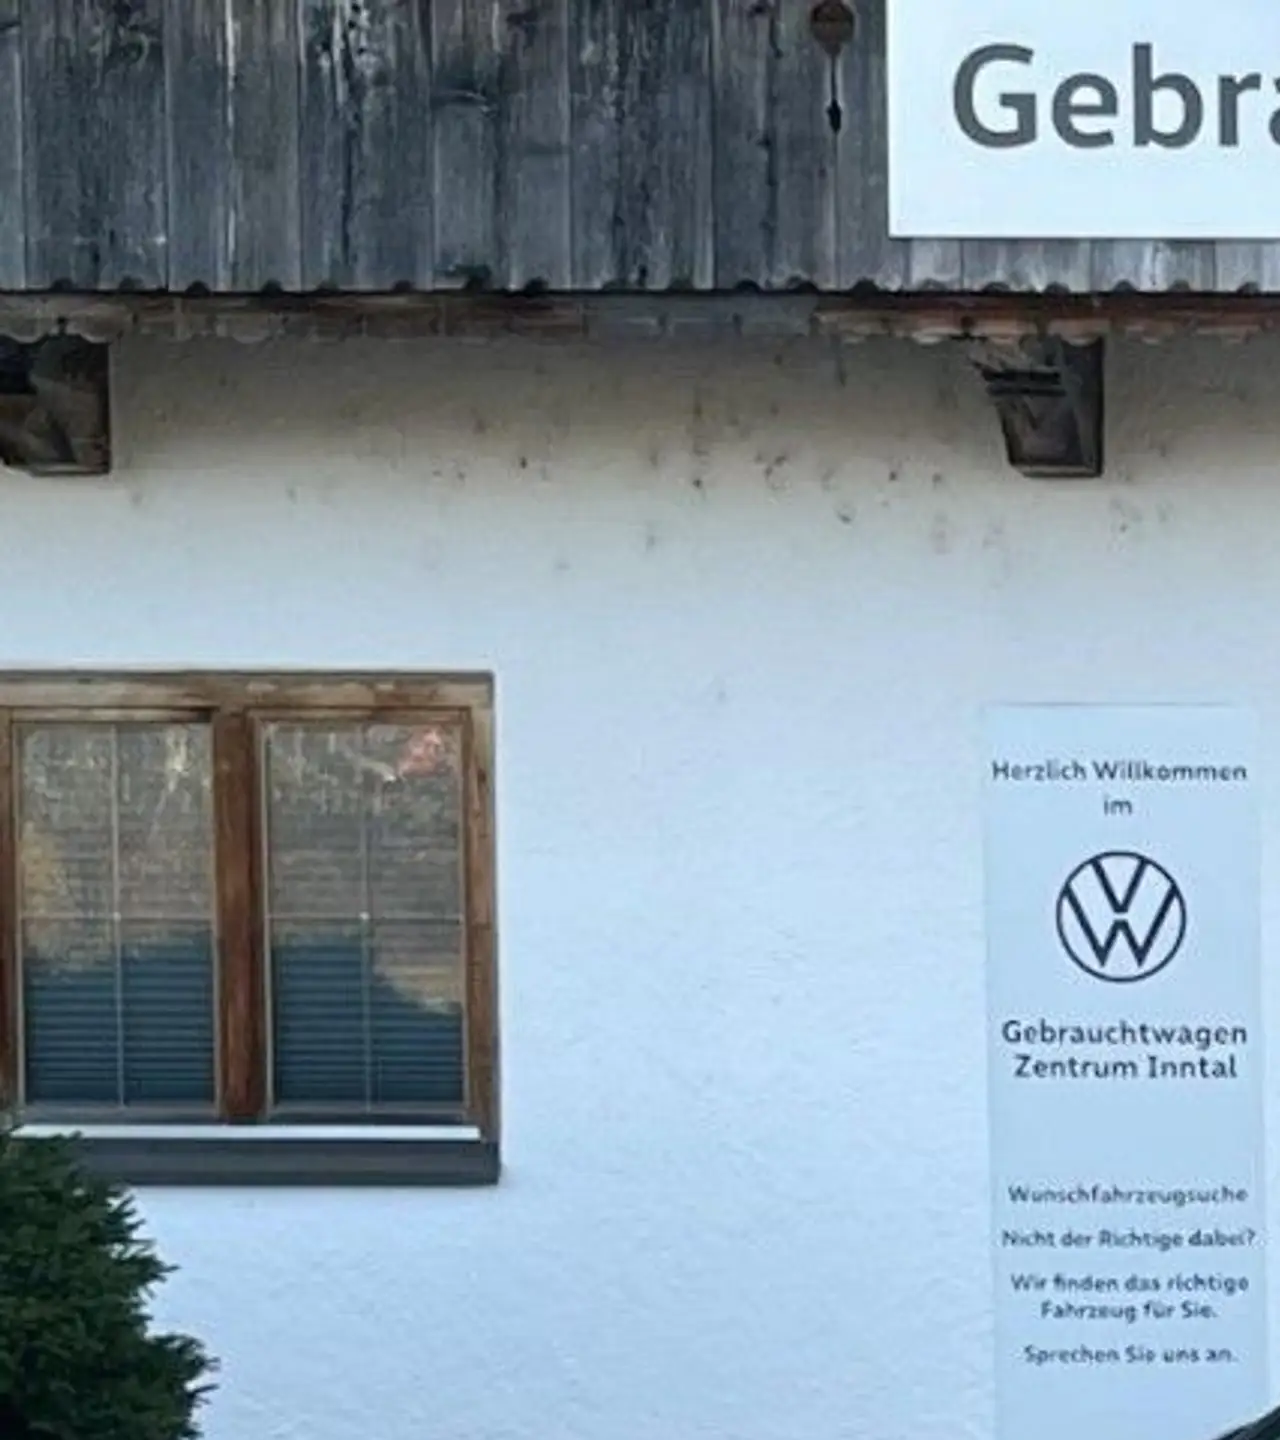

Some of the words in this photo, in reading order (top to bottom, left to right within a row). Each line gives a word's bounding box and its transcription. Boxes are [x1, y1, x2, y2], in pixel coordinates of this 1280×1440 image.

[991, 760, 1086, 782] Herzlich
[1092, 760, 1248, 781] Willkommen
[1103, 795, 1133, 816] im
[1001, 1018, 1248, 1051] Gebrauchtwagen
[1013, 1055, 1138, 1080] Zentrum
[1148, 1055, 1237, 1079] Inntal
[1008, 1184, 1249, 1209] Wunschfahrzeugsuche
[1001, 1230, 1055, 1248] Nicht
[1060, 1230, 1092, 1247] der
[1098, 1229, 1184, 1252] Richtige
[1188, 1228, 1256, 1248] dabei?
[1010, 1273, 1047, 1291] Wir
[1053, 1273, 1118, 1292] finden
[1124, 1274, 1161, 1292] das
[1166, 1273, 1250, 1295] richtige
[1040, 1301, 1138, 1325] Fahrzeug
[1143, 1300, 1176, 1320] für
[1180, 1300, 1218, 1320] Sie.
[1023, 1344, 1121, 1367] Sprechen
[1124, 1344, 1157, 1364] Sie
[1162, 1347, 1201, 1364] uns
